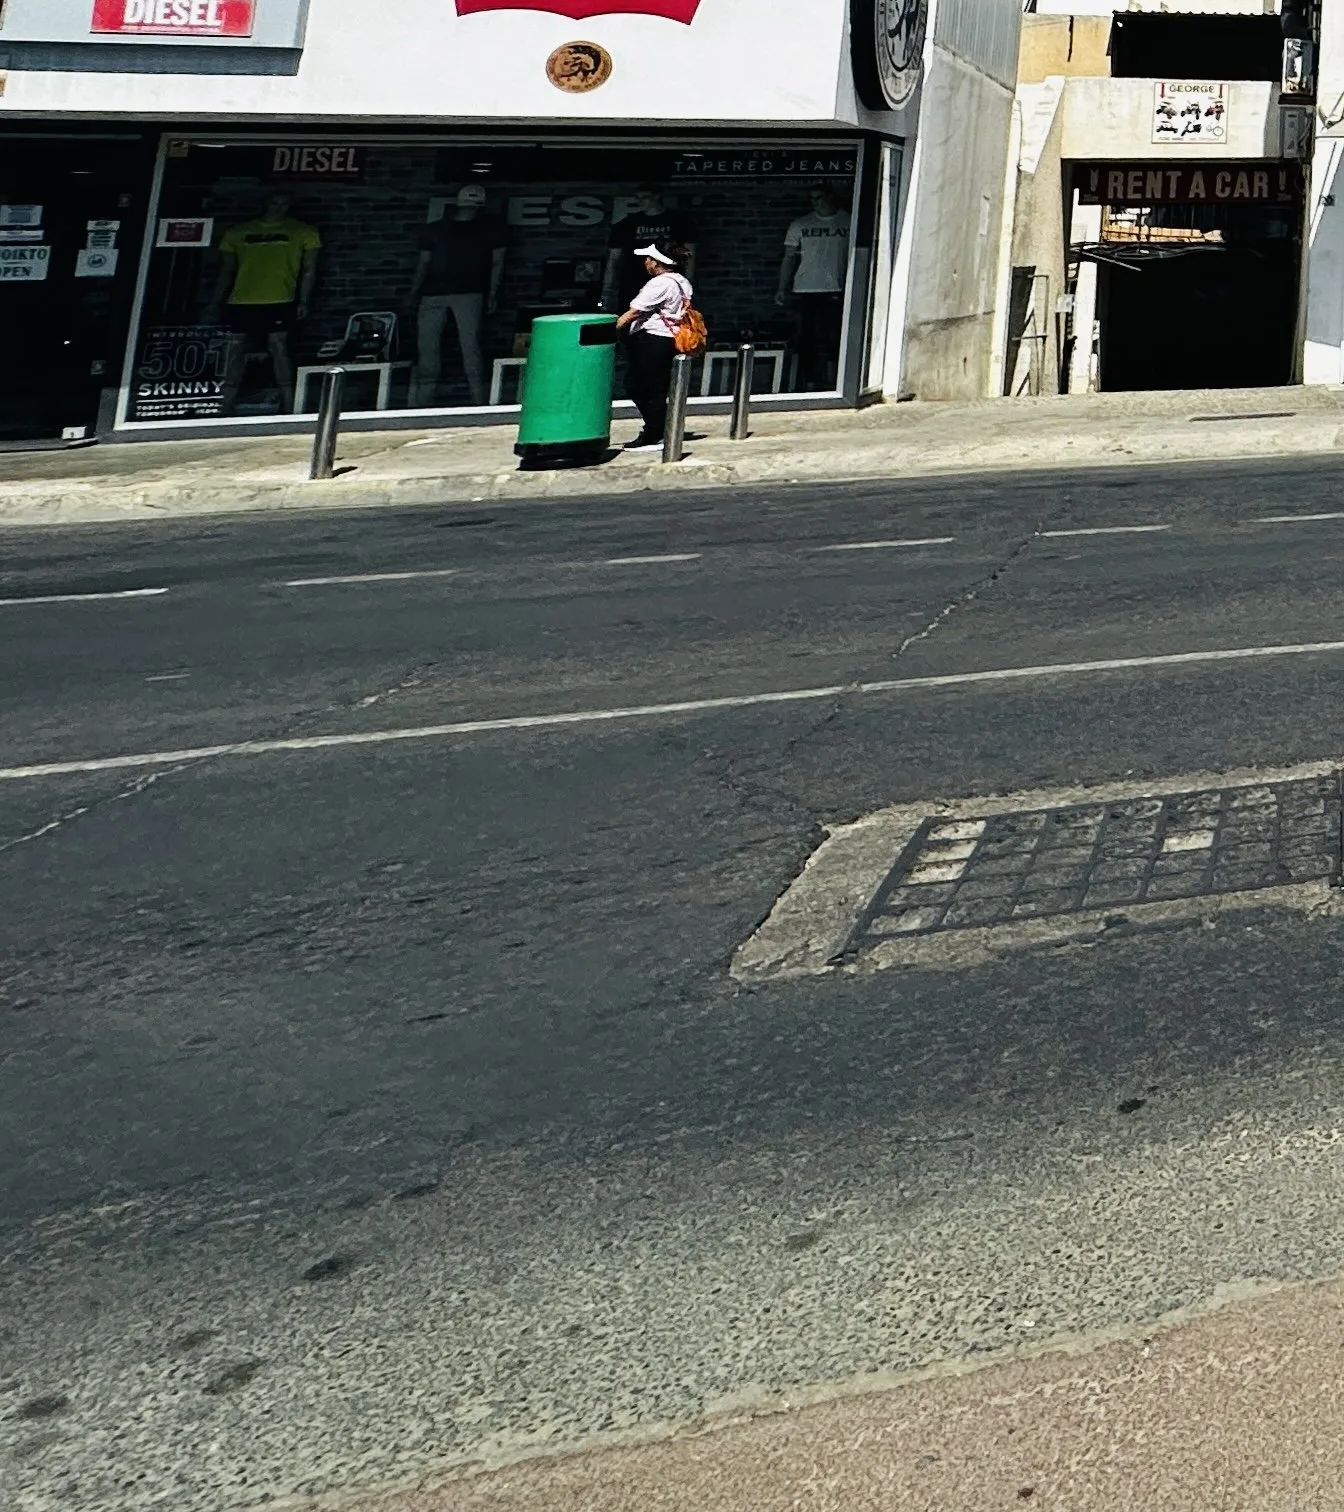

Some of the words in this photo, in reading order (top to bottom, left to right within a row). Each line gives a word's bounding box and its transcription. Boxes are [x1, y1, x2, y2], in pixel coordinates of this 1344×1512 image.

[1169, 84, 1215, 93] GEORGE
[273, 147, 359, 172] DIESEL
[674, 161, 774, 173] TAPERED
[784, 160, 854, 172] JEANS
[1106, 170, 1182, 200] RENT
[1188, 171, 1206, 200] A
[1215, 171, 1269, 199] CAR
[0, 266, 31, 277] PEN
[139, 340, 231, 380] 501
[137, 381, 226, 397] SKINNY
